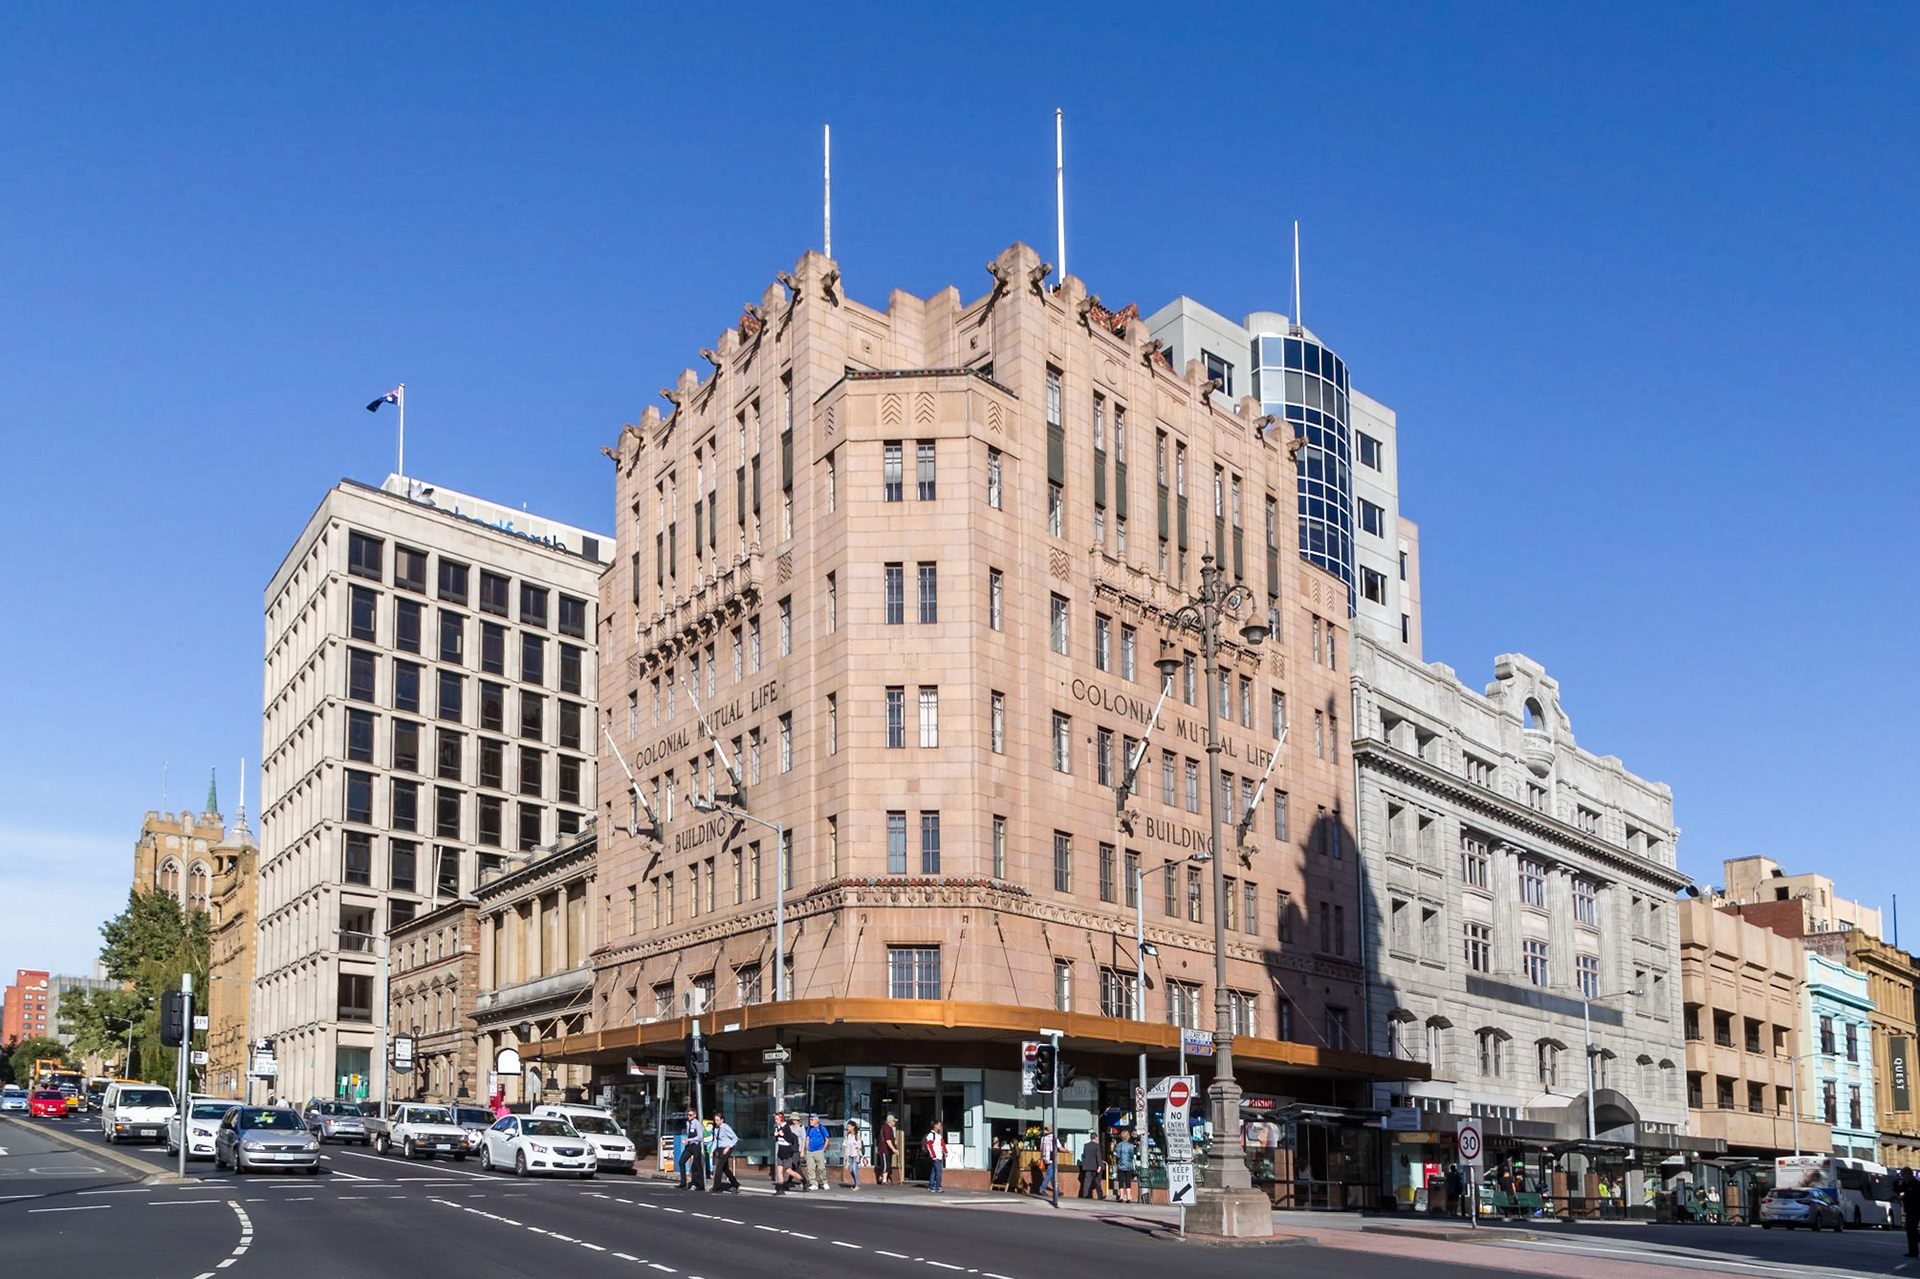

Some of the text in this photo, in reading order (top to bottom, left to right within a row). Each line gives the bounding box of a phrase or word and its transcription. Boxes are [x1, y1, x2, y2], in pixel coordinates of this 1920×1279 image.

[635, 680, 778, 770] COLONIAL MUTUAL LIFE
[1072, 678, 1166, 731] COLONIAL
[1176, 717, 1238, 758] MUTAL
[675, 816, 726, 853] BUILDING
[1894, 1057, 1905, 1090] QUEST
[1171, 1112, 1182, 1120] NO
[1462, 1136, 1476, 1151] 30
